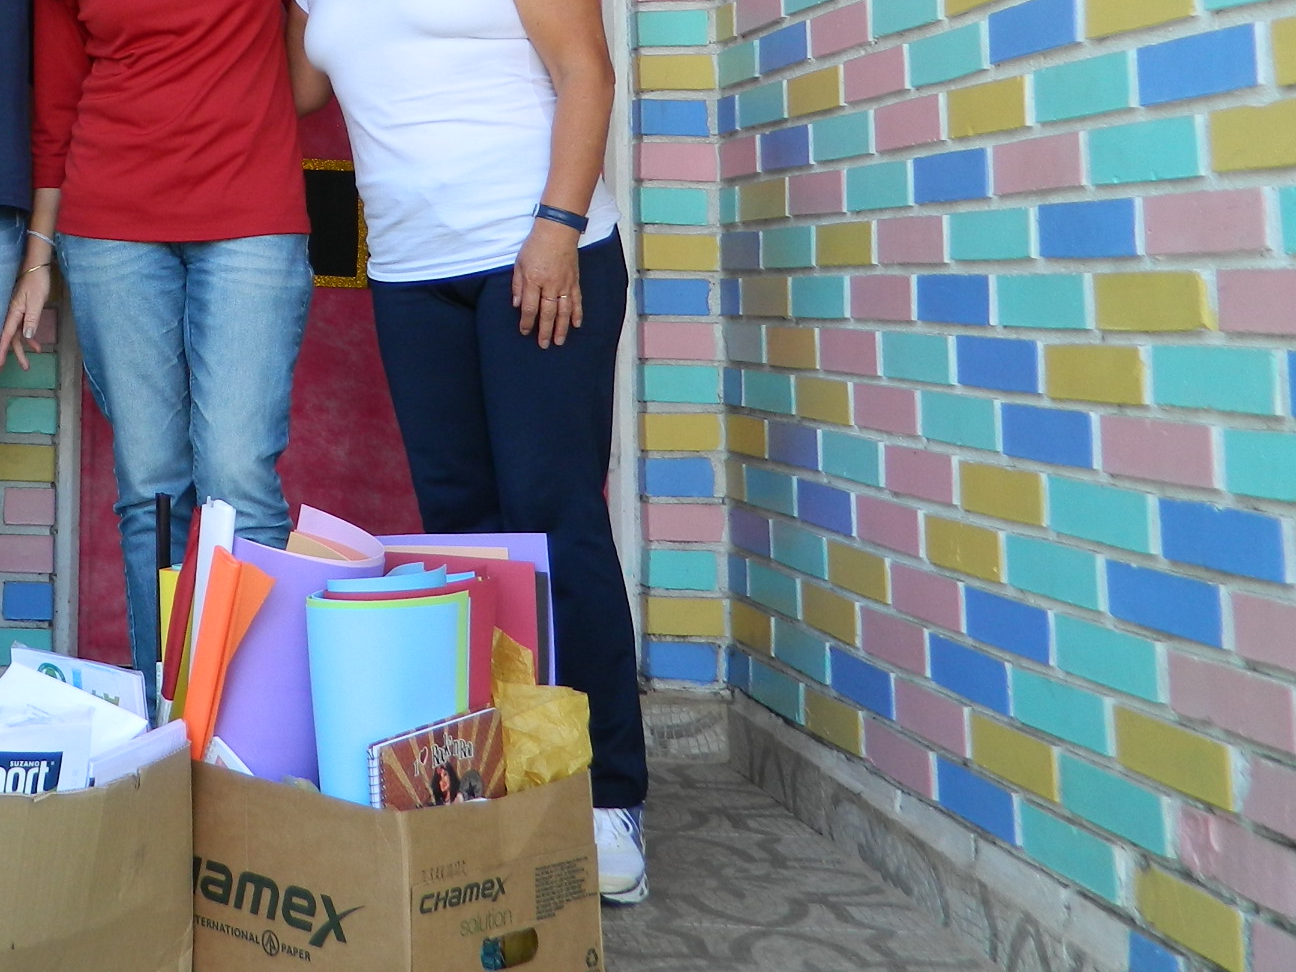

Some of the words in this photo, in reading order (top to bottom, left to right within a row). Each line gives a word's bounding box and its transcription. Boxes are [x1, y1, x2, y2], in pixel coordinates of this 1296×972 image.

[193, 856, 366, 948] amex
[460, 908, 513, 937] solution
[193, 914, 260, 945] TERNATIONAL
[281, 942, 311, 962] PAPER
